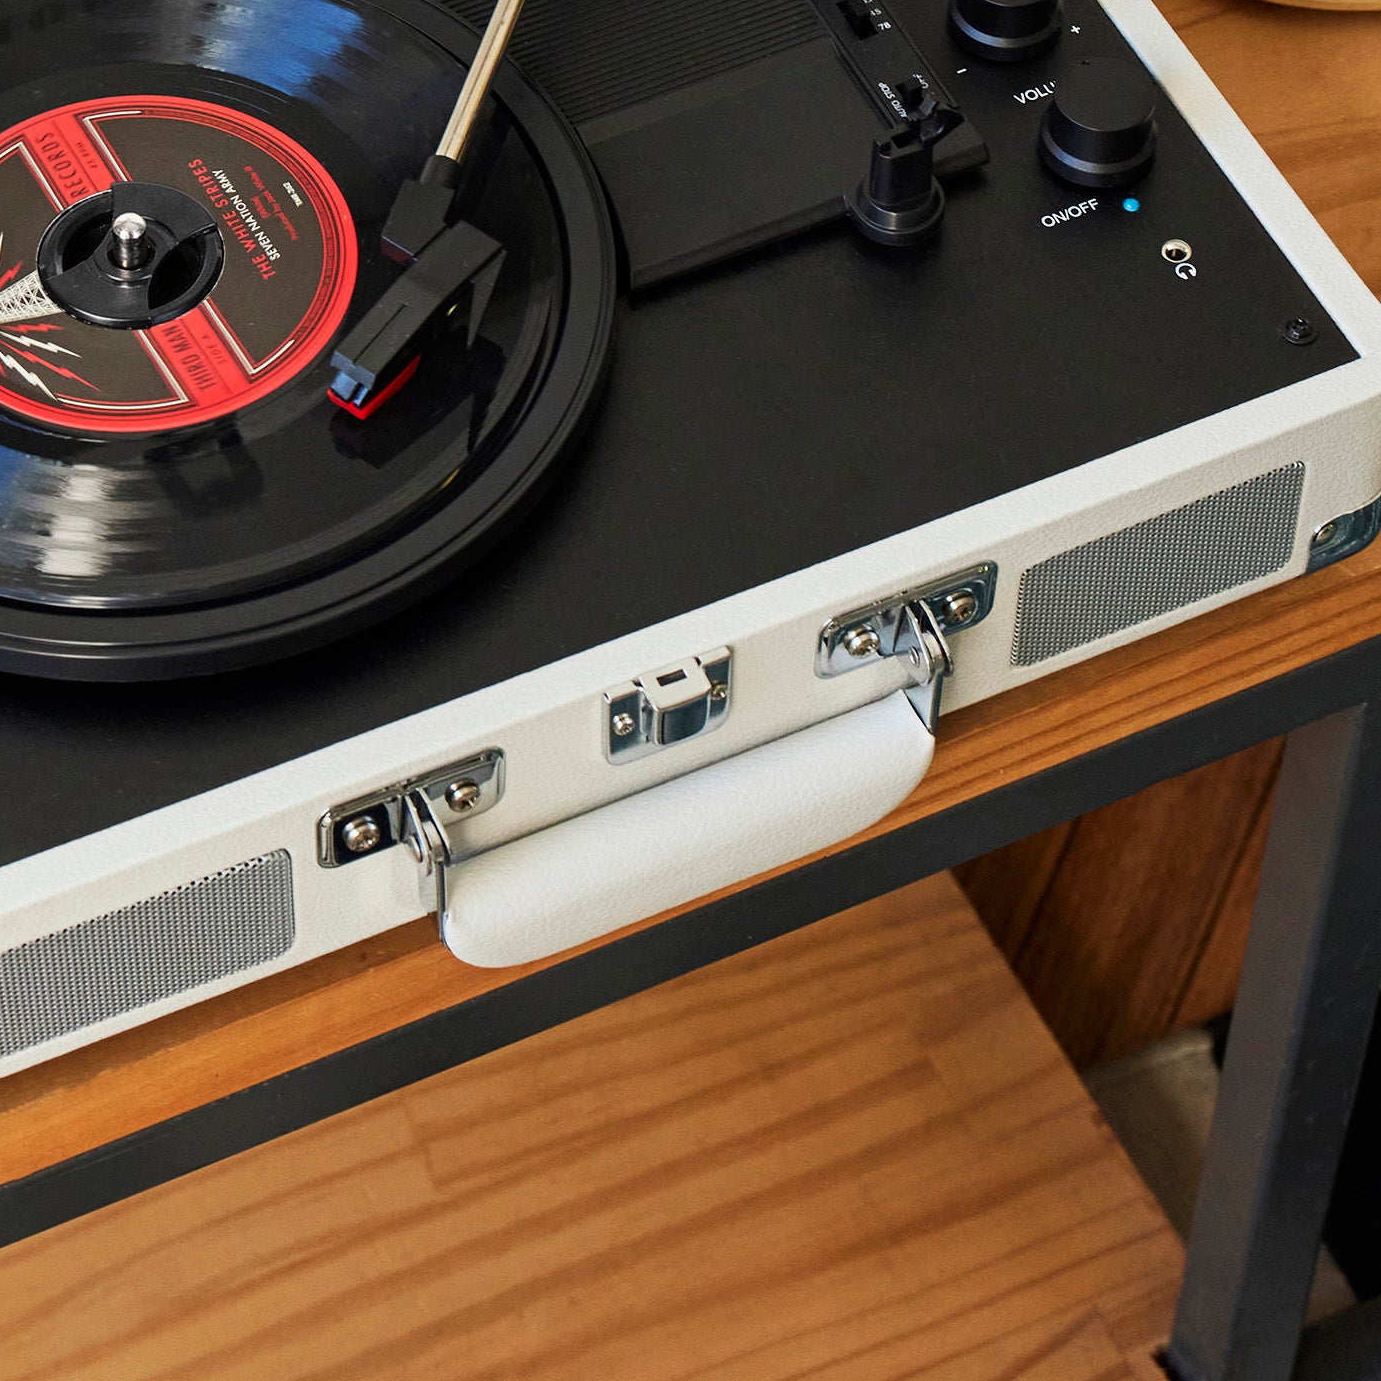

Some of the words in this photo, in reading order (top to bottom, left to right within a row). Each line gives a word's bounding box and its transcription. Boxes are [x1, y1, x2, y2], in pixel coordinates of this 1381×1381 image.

[877, 21, 892, 31] 78
[878, 82, 896, 100] STOP
[892, 100, 907, 118] AUTO
[38, 132, 89, 198] RECORDS
[189, 158, 229, 208] STRIPES
[213, 169, 236, 193] ARMY
[230, 195, 260, 231] NATION
[1040, 198, 1099, 228] ON/OFF
[223, 209, 256, 253] WHITE
[255, 231, 280, 261] SEVEN
[253, 254, 276, 280] THE
[163, 324, 192, 354] MAN
[180, 354, 217, 390] THIRD
